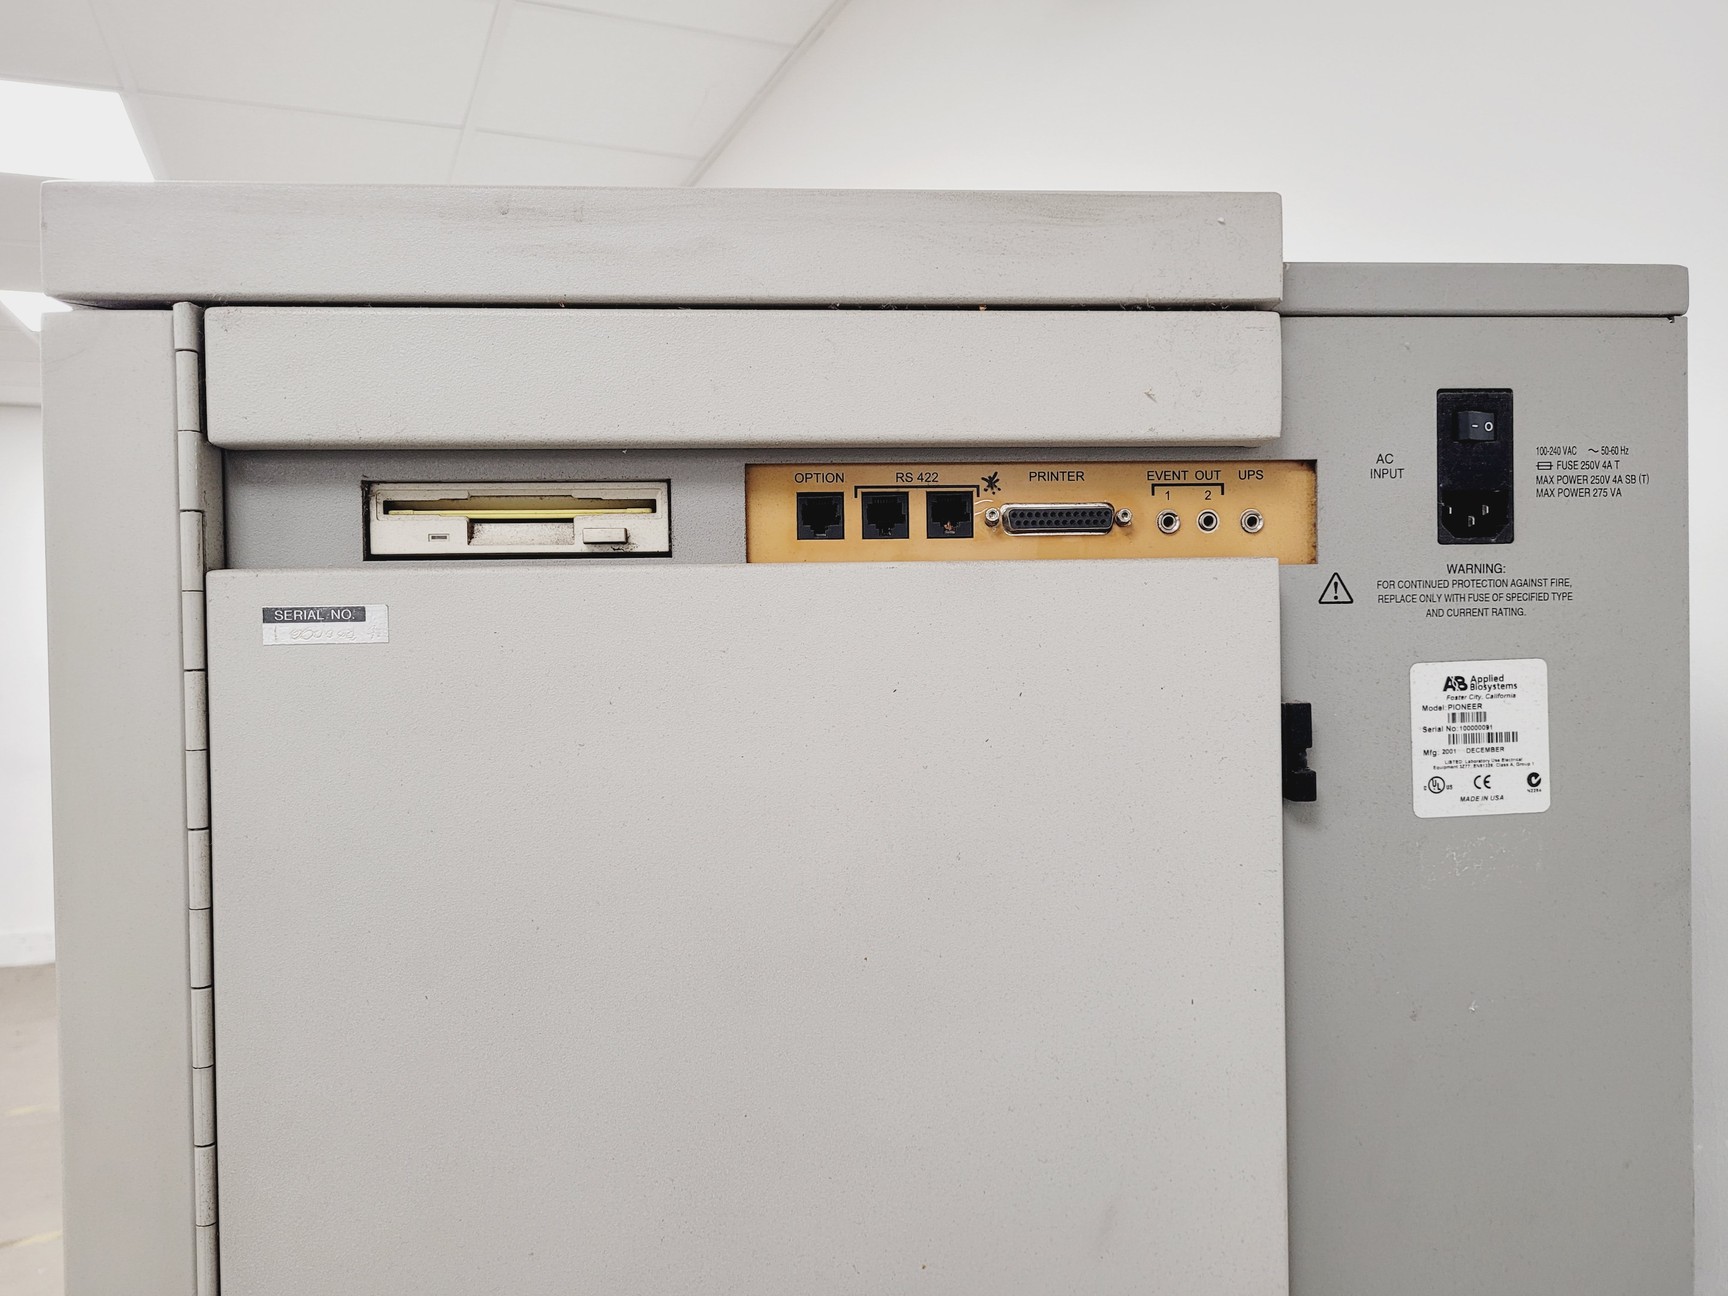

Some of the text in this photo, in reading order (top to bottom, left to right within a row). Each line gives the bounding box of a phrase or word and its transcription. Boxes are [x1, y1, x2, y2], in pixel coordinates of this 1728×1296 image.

[1536, 446, 1629, 455] 100-240 VAC 50-60 Hz
[1376, 453, 1394, 464] AC
[1556, 460, 1621, 470] FUSE 250V 4A T
[794, 472, 845, 483] OPTION
[895, 472, 939, 483] RS 422
[1029, 471, 1085, 482] PRINTER
[1146, 470, 1222, 481] EVENT OUT
[1238, 469, 1264, 481] UPS
[1370, 468, 1405, 479] INPUT
[1535, 473, 1650, 485] MAX POWER 250V 4A SB (T)
[1164, 490, 1212, 501] 1 2
[1535, 488, 1622, 498] MAX POWER 275 VA
[1446, 563, 1506, 574] WARNING:
[1376, 578, 1573, 590] FOR CONTINUED PROTECTION AGAINST FIRE,
[1377, 592, 1573, 604] REPLACE ONLY WITH FUSE OF SPECIFIED TYPE
[274, 609, 355, 621] SERIAL NO.
[1425, 607, 1527, 618] AND CURRENT RATING.
[1470, 674, 1505, 685] Applied
[1470, 682, 1518, 692] Biosystems
[1473, 774, 1492, 789] CE
